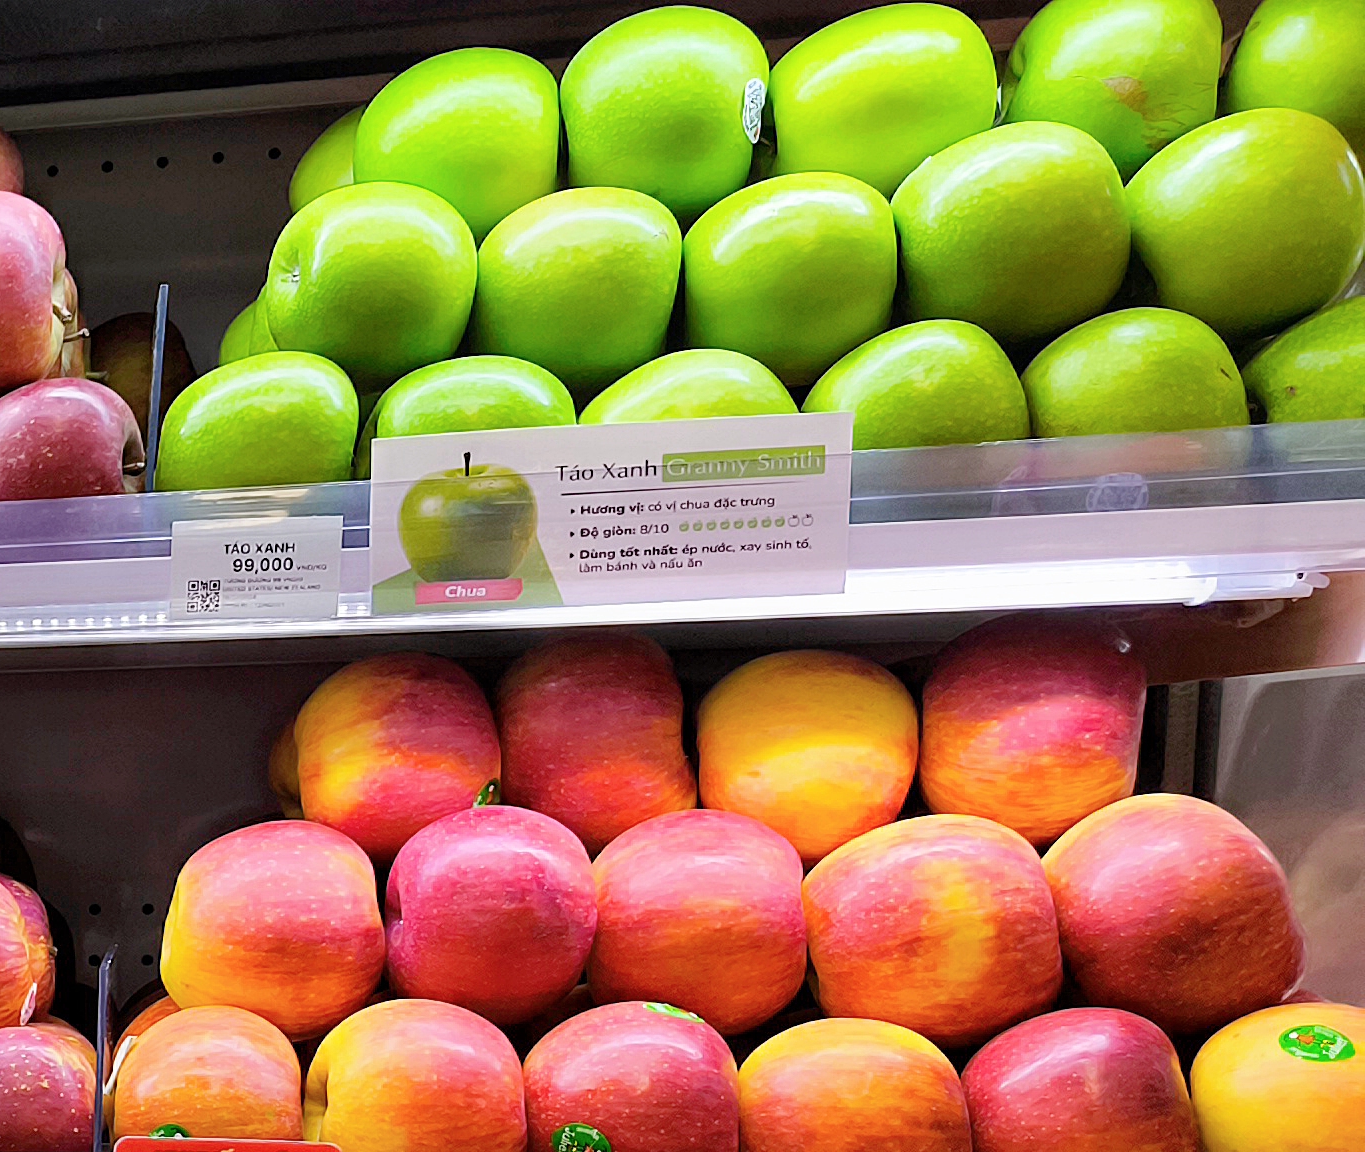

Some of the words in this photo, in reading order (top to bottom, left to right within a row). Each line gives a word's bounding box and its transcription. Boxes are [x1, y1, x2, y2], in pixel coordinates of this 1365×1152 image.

[555, 465, 594, 482] Táo
[602, 459, 658, 479] Xanh
[666, 457, 747, 477] Granny
[757, 451, 820, 471] Smith
[580, 504, 625, 516] Hương
[629, 503, 644, 515] vị:
[648, 501, 662, 512] có
[665, 502, 677, 513] vị
[680, 500, 710, 510] chua
[713, 497, 737, 509] đặc
[741, 497, 775, 508] trưng
[580, 527, 599, 539] Độ
[603, 526, 636, 539] giòn:
[640, 524, 669, 535] 8/10
[224, 541, 250, 555] TÁO
[255, 542, 296, 554] XANH
[579, 549, 616, 561] Dùng
[620, 547, 639, 558] tốt
[682, 544, 697, 556] ép
[740, 544, 761, 553] xay
[766, 539, 792, 550] sinh
[232, 557, 294, 574] 99,000
[579, 563, 602, 573] làm
[607, 561, 637, 572] bánh
[642, 561, 656, 570] và
[660, 558, 683, 569] nấu
[688, 558, 702, 568] ăn
[444, 584, 486, 598] Chua
